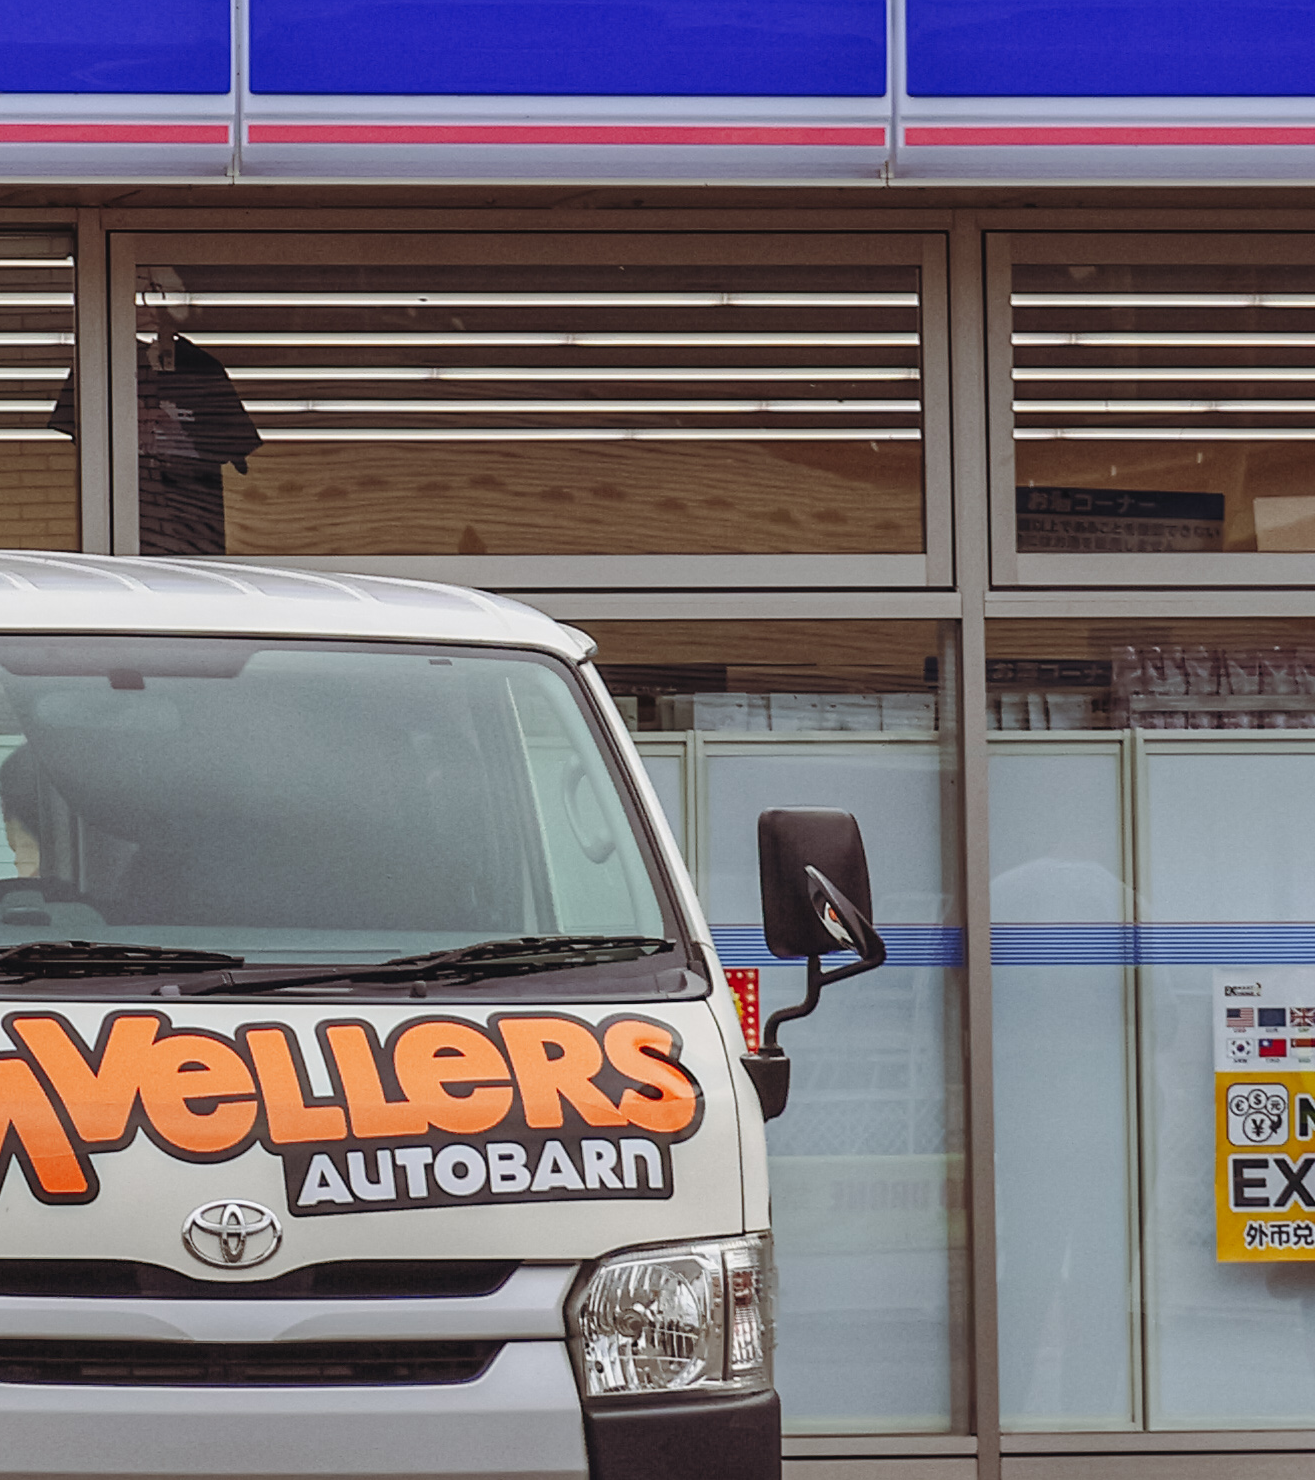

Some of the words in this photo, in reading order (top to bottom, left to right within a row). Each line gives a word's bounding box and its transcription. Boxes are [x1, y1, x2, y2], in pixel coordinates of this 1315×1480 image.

[1232, 1158, 1315, 1208] EX
[1246, 1223, 1314, 1247] 外币兑
